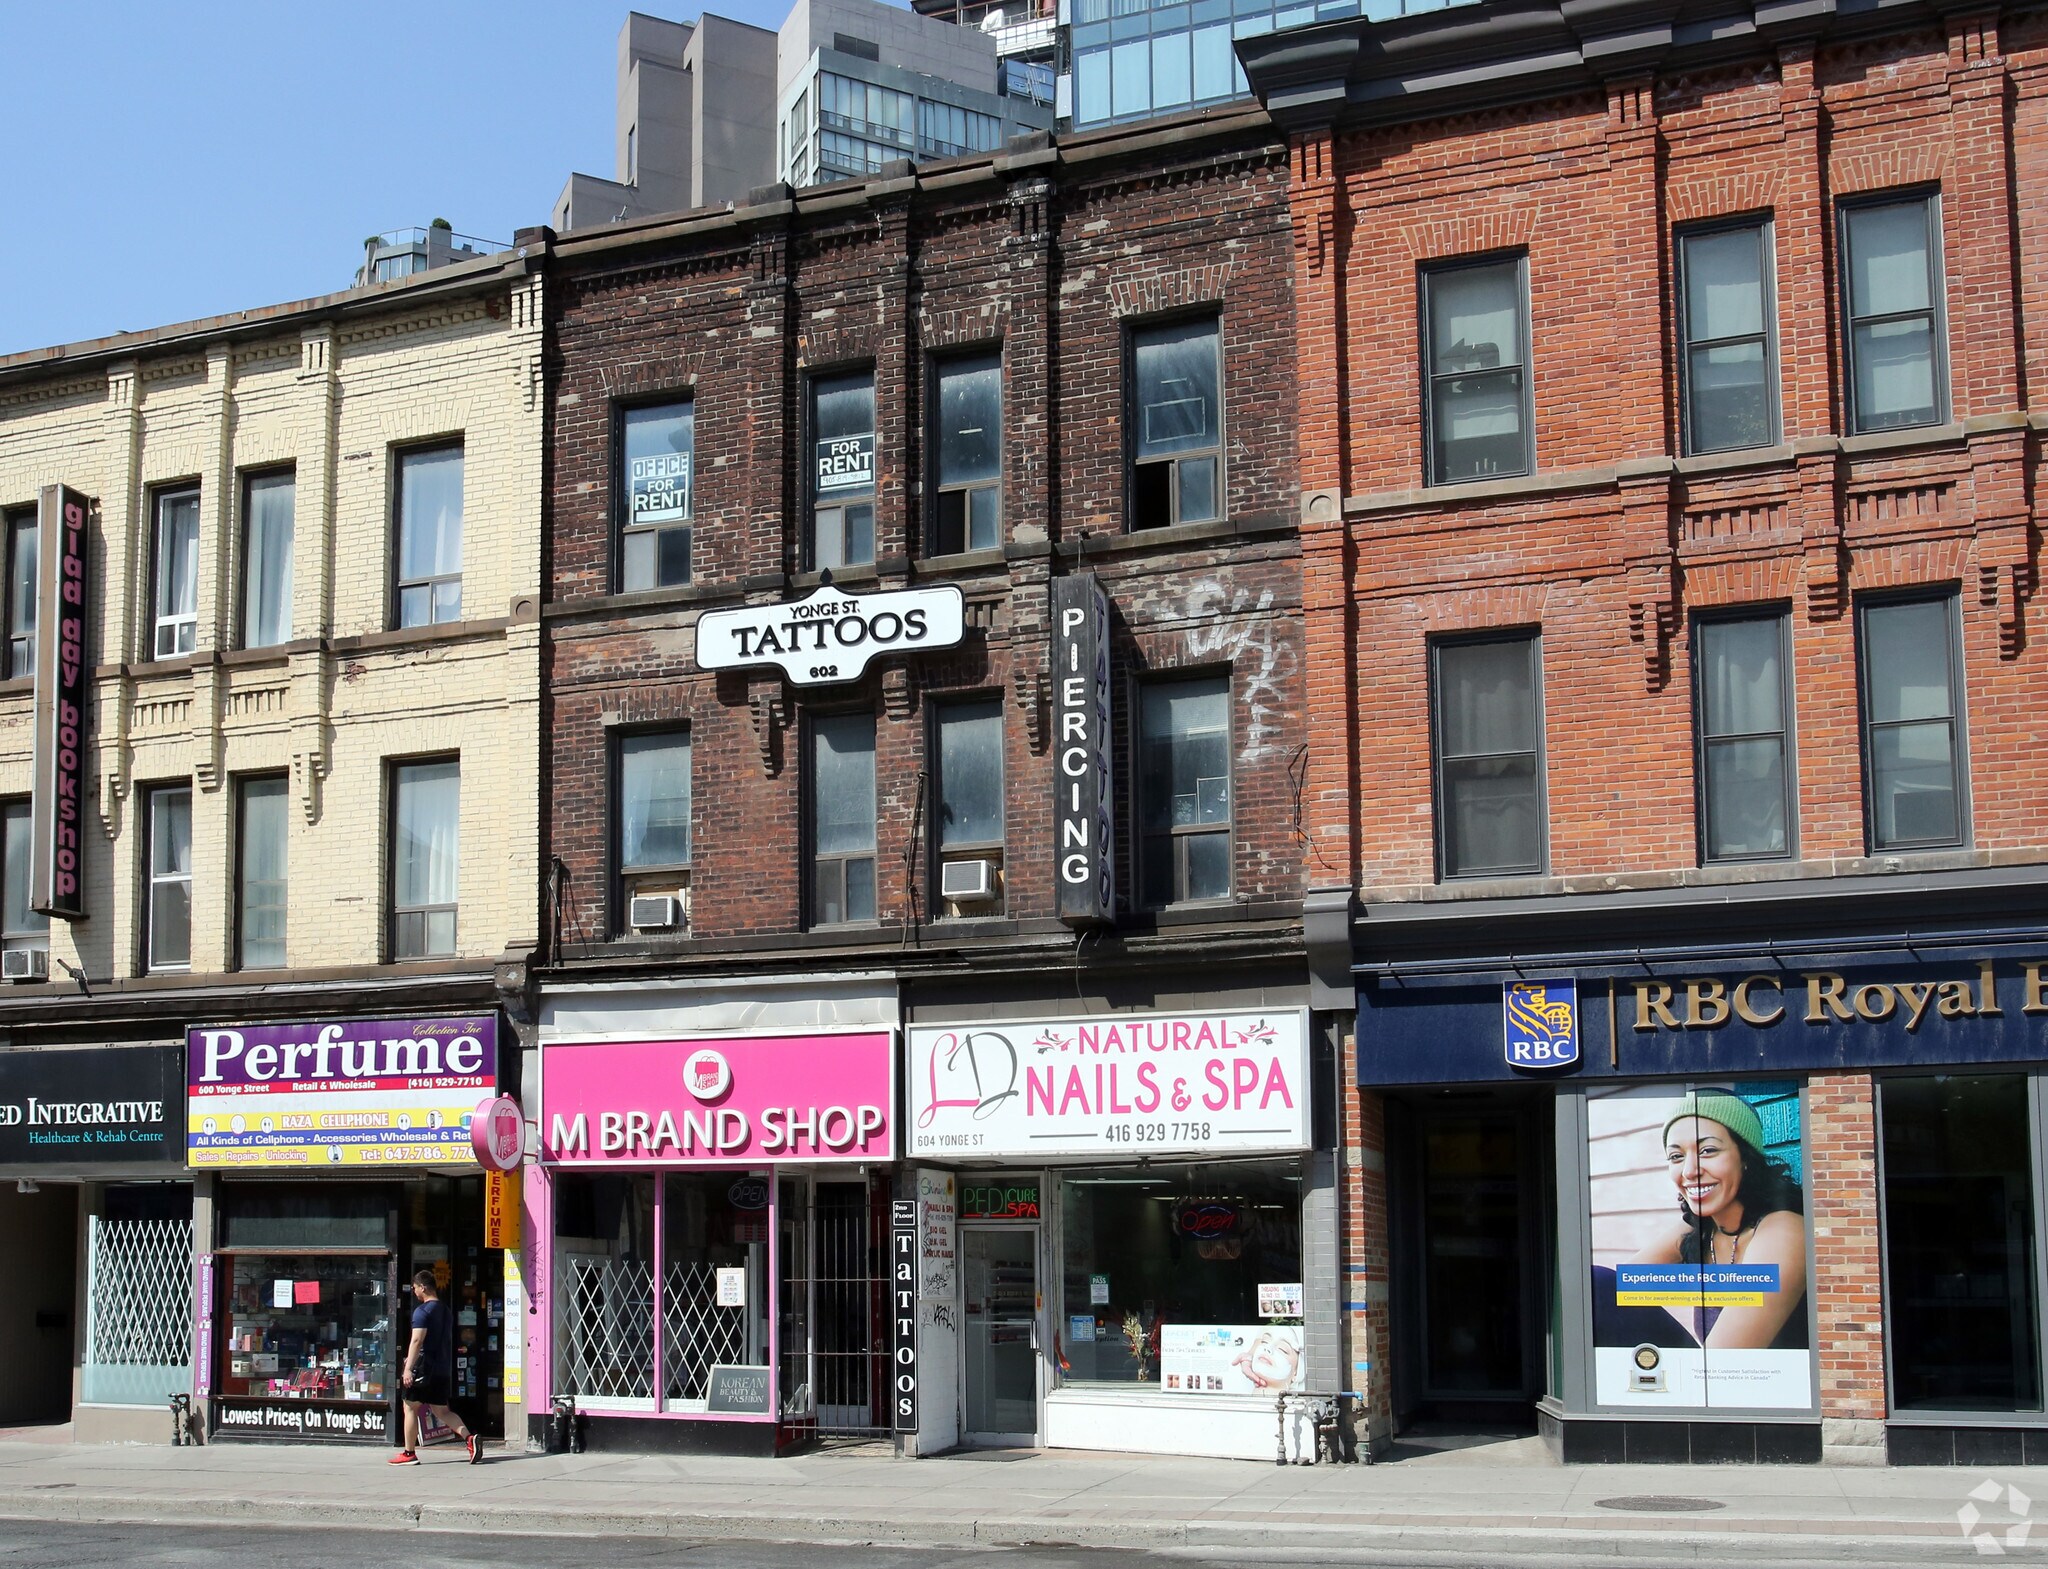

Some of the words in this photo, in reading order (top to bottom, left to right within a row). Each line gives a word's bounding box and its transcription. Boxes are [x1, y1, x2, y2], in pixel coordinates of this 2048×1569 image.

[831, 440, 861, 456] FOR
[632, 455, 689, 478] OFFICE
[819, 451, 873, 475] RENT
[647, 479, 674, 493] FOR
[634, 489, 685, 511] RENT
[789, 602, 838, 619] YONGE
[842, 600, 860, 614] ST.
[731, 608, 929, 658] TATTOOS
[61, 618, 81, 688] day
[809, 664, 838, 678] 602
[1061, 607, 1090, 884] PIERCING
[56, 698, 79, 896] bookshop
[1629, 975, 1786, 1029] RBC
[1801, 958, 2003, 1032] Royal
[412, 1023, 458, 1038] Collection
[463, 1025, 482, 1035] Inc
[1079, 1019, 1237, 1055] NATURAL
[199, 1024, 484, 1082] Perfume
[1513, 1040, 1571, 1060] RBC
[199, 1085, 214, 1094] 600
[215, 1084, 241, 1096] Yonge
[244, 1084, 270, 1093] Street
[292, 1081, 318, 1091] Retail
[320, 1082, 327, 1091] &
[329, 1080, 376, 1090] Wholesale
[408, 1078, 433, 1089] (416)
[435, 1077, 482, 1087] 929-7710
[1026, 1061, 1161, 1117] NAILS
[1171, 1077, 1192, 1112] &
[1202, 1056, 1294, 1111] SPA
[27, 1098, 164, 1125] INTEGRATIVE
[281, 1115, 314, 1129] RAZA
[320, 1112, 390, 1127] CELLPHONE
[29, 1131, 80, 1143] Healthcare
[83, 1132, 93, 1143] &
[96, 1130, 127, 1142] Rehab
[129, 1129, 164, 1142] Centre
[551, 1113, 588, 1151] M
[600, 1109, 750, 1151] BRAND
[760, 1105, 884, 1149] SHOP
[1105, 1125, 1130, 1142] 416
[1136, 1123, 1166, 1141] 929
[1171, 1122, 1211, 1141] 7758
[196, 1136, 209, 1146] All
[211, 1136, 240, 1145] Kinds
[242, 1135, 253, 1144] of
[255, 1134, 304, 1146] Cellphone
[313, 1133, 377, 1143] Accessories
[380, 1132, 438, 1141] Wholesale
[440, 1131, 450, 1140] &
[917, 1135, 936, 1147] 604
[939, 1134, 969, 1146] YONGE
[972, 1134, 984, 1145] ST
[196, 1151, 219, 1161] Sales
[225, 1150, 259, 1163] Repairs
[266, 1150, 307, 1162] Unlocking
[360, 1149, 381, 1160] Tel:
[731, 1186, 769, 1201] OPEN
[490, 1170, 501, 1247] ERFUMES
[1007, 1203, 1039, 1217] SPA
[1182, 1211, 1236, 1232] Open
[1622, 1273, 1676, 1284] Experience
[1678, 1273, 1695, 1283] the
[1719, 1273, 1774, 1283] Difference.
[507, 1297, 519, 1306] Bell
[1653, 1295, 1691, 1303] award-winning
[720, 1388, 748, 1396] BEAUTY
[721, 1377, 766, 1389] KOREAN
[728, 1395, 764, 1403] FASHION
[222, 1405, 263, 1425] Lowest
[266, 1407, 302, 1427] Prices
[305, 1408, 321, 1428] On
[324, 1409, 361, 1434] Yonge
[363, 1411, 385, 1430] Str.
